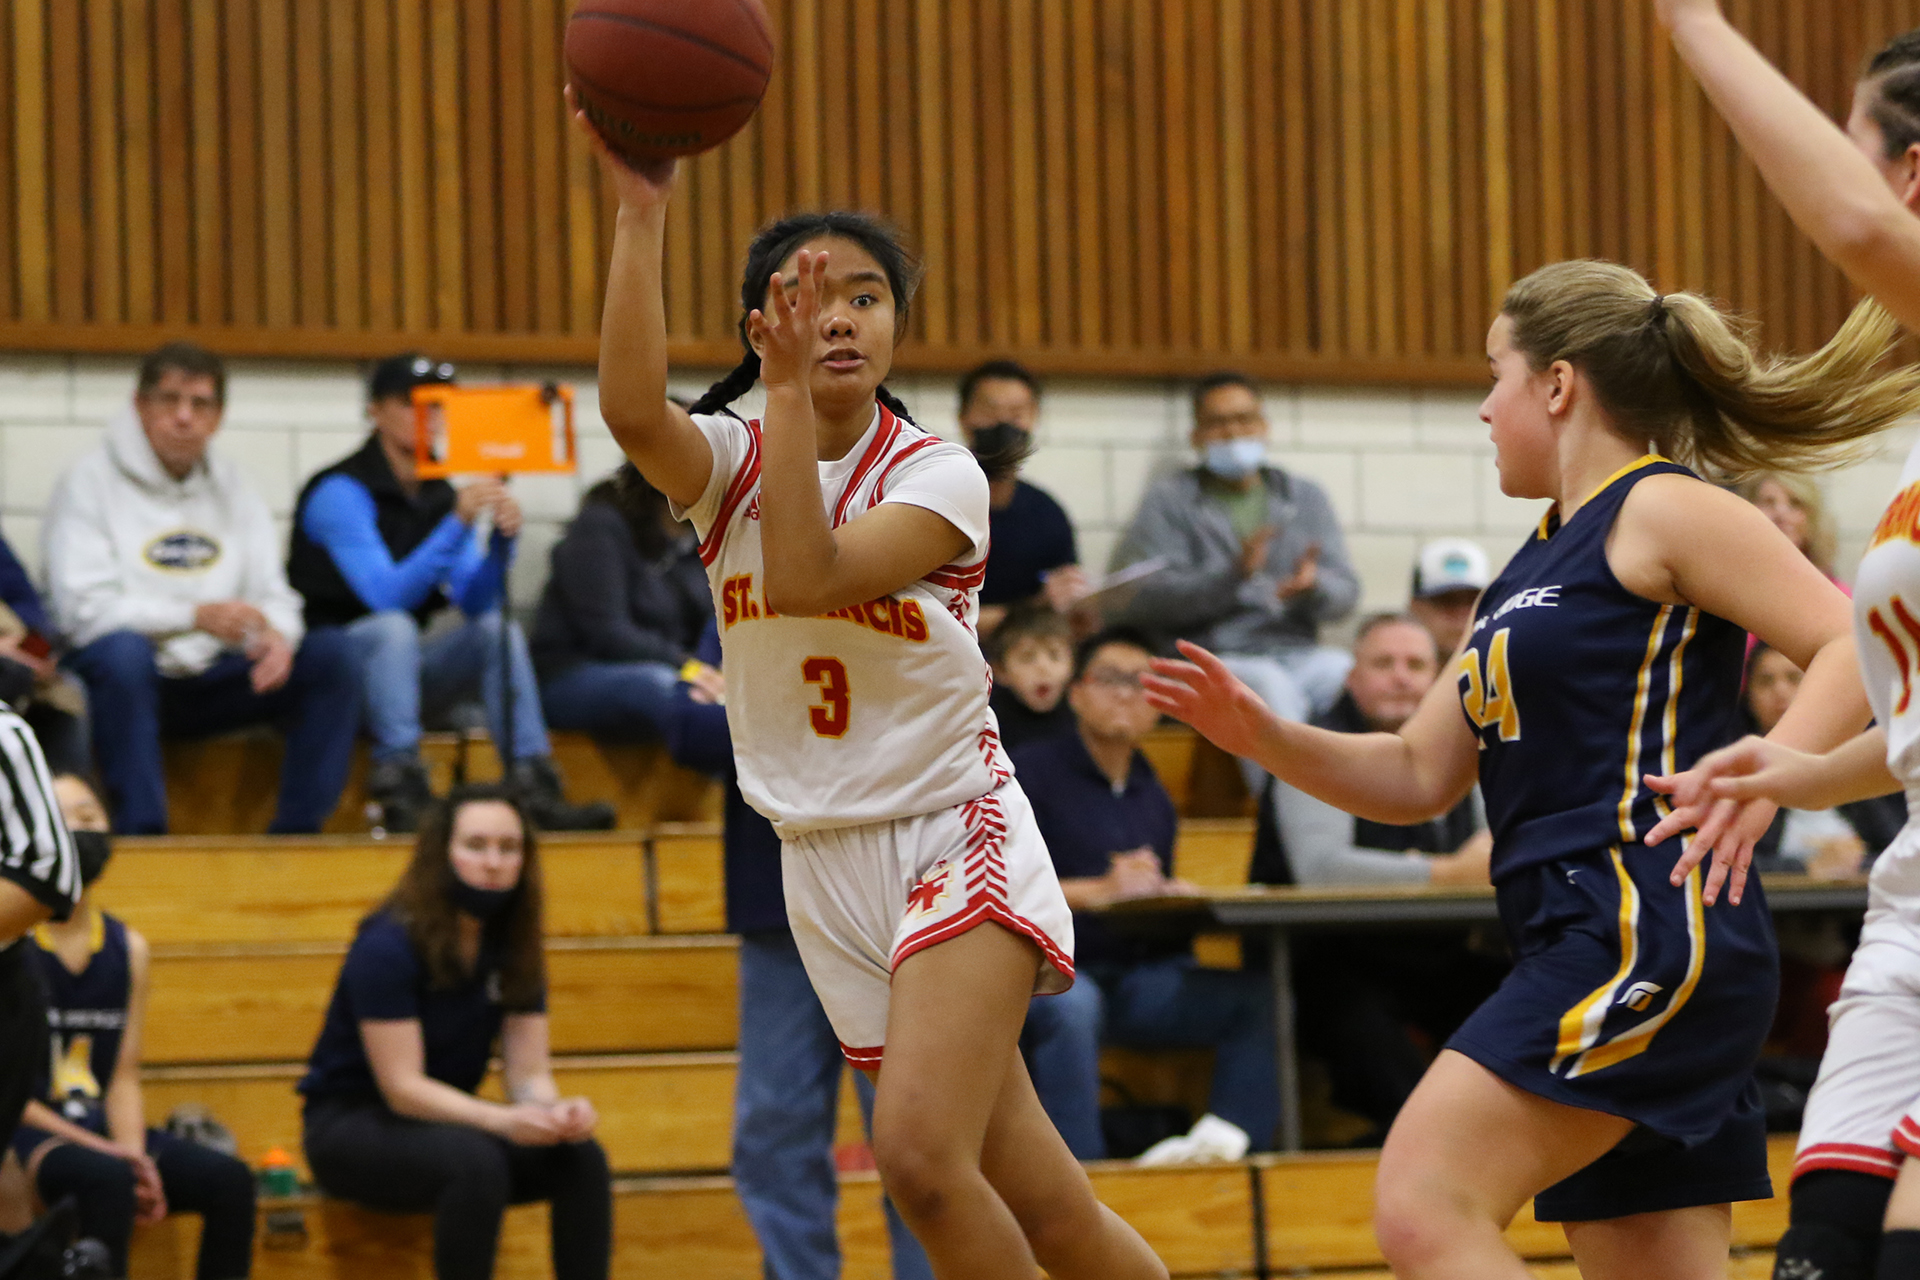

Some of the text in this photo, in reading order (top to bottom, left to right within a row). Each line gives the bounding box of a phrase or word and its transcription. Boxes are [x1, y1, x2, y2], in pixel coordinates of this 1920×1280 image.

[722, 572, 760, 632] ST.
[801, 655, 852, 740] 3
[1458, 627, 1522, 751] 24
